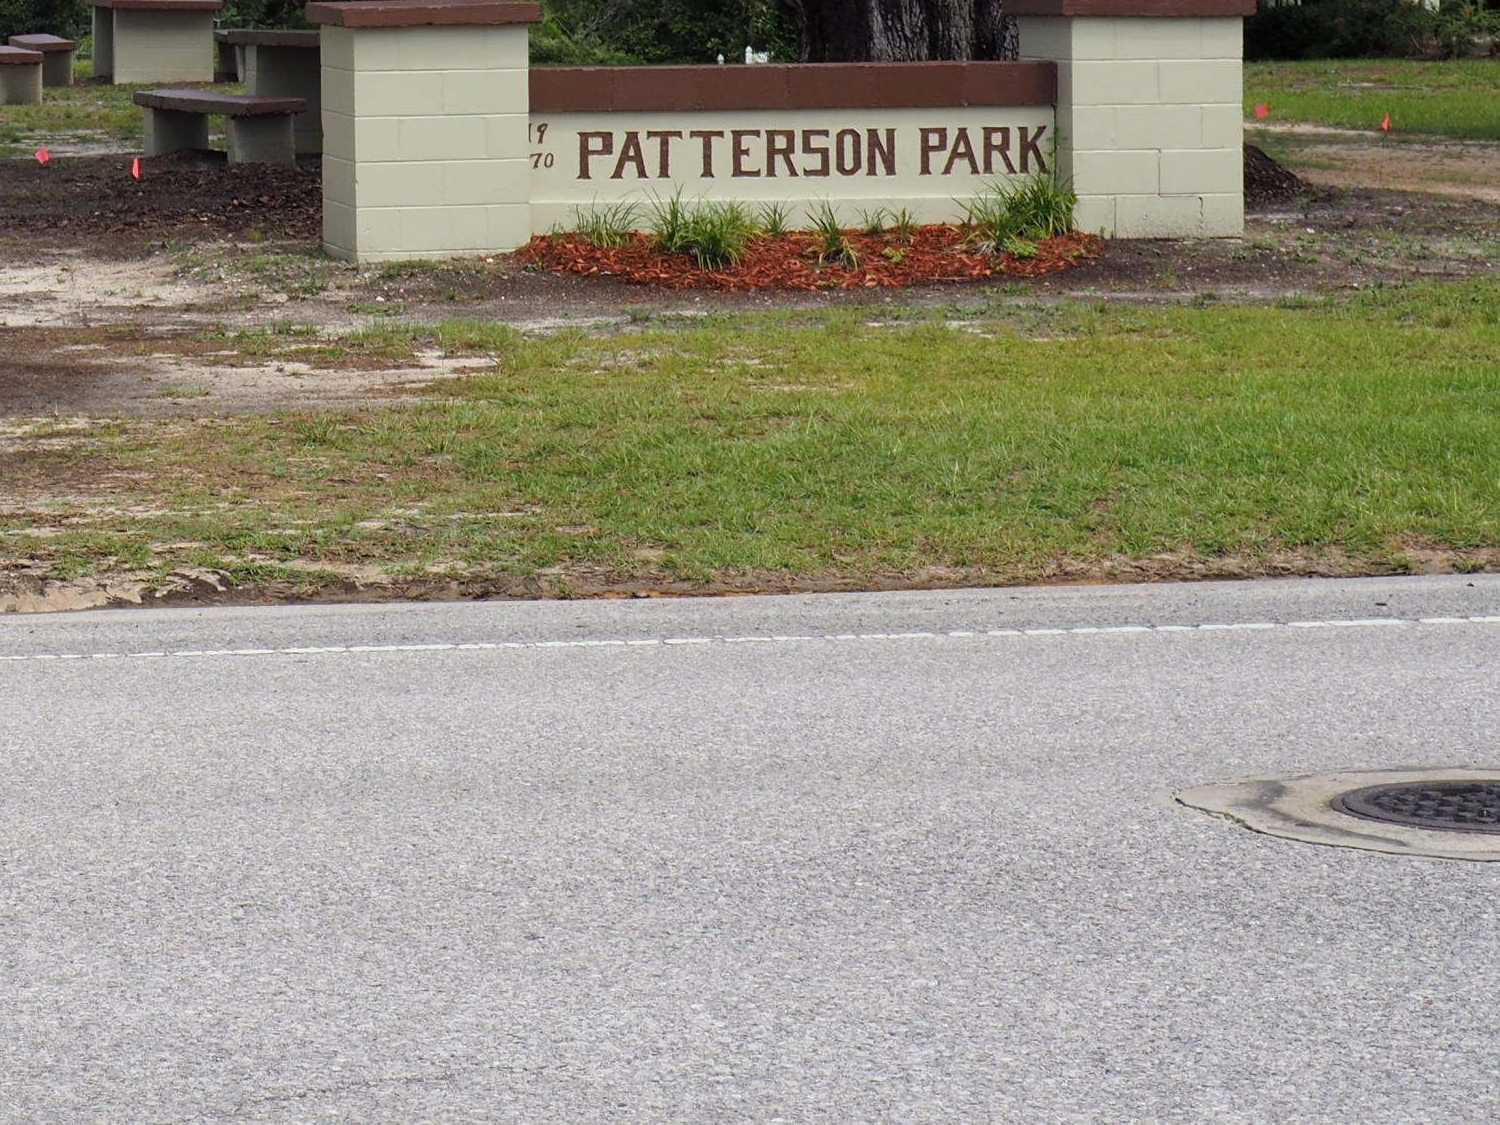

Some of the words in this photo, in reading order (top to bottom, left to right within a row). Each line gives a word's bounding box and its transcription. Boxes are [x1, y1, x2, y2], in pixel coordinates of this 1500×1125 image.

[529, 152, 554, 169] 70
[576, 127, 897, 179] PATTERSON
[918, 125, 1050, 175] PARK
